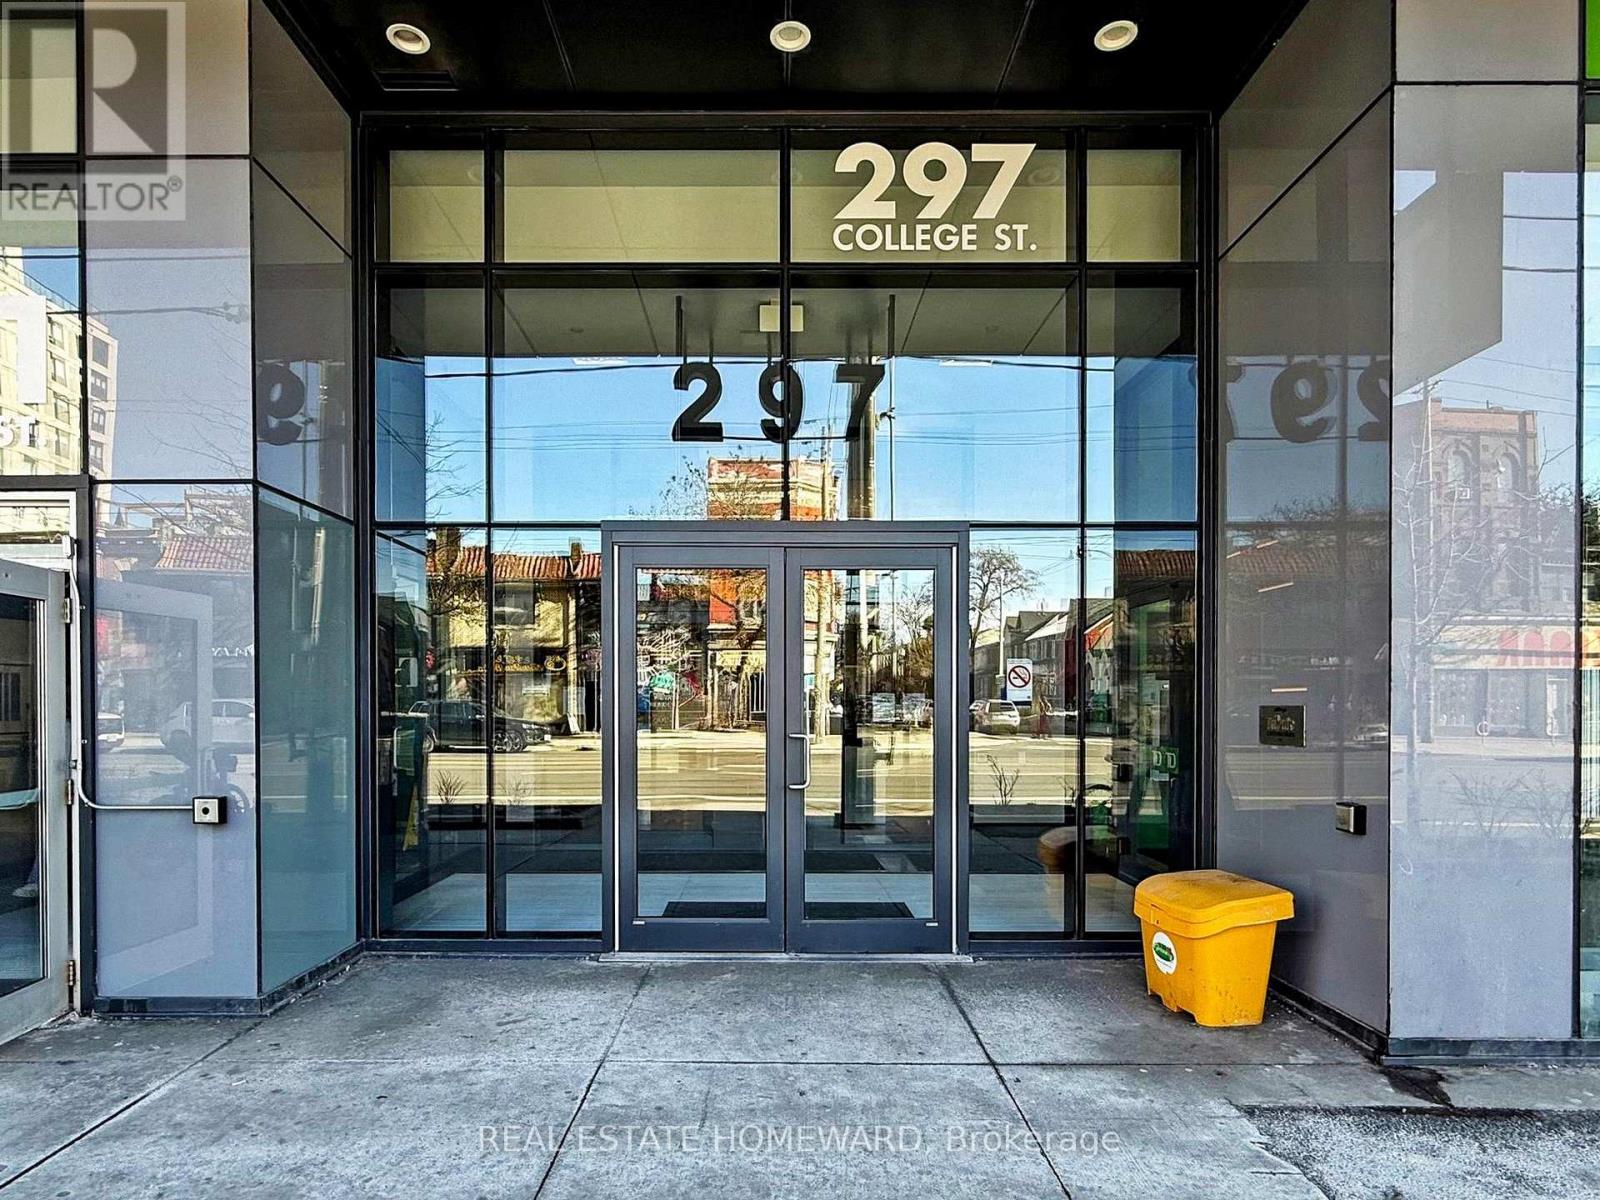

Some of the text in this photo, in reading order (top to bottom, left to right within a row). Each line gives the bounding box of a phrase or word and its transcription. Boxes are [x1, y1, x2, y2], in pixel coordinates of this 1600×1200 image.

[834, 141, 1036, 219] 297
[833, 223, 1037, 251] COLLEGE ST.
[672, 361, 885, 443] 297
